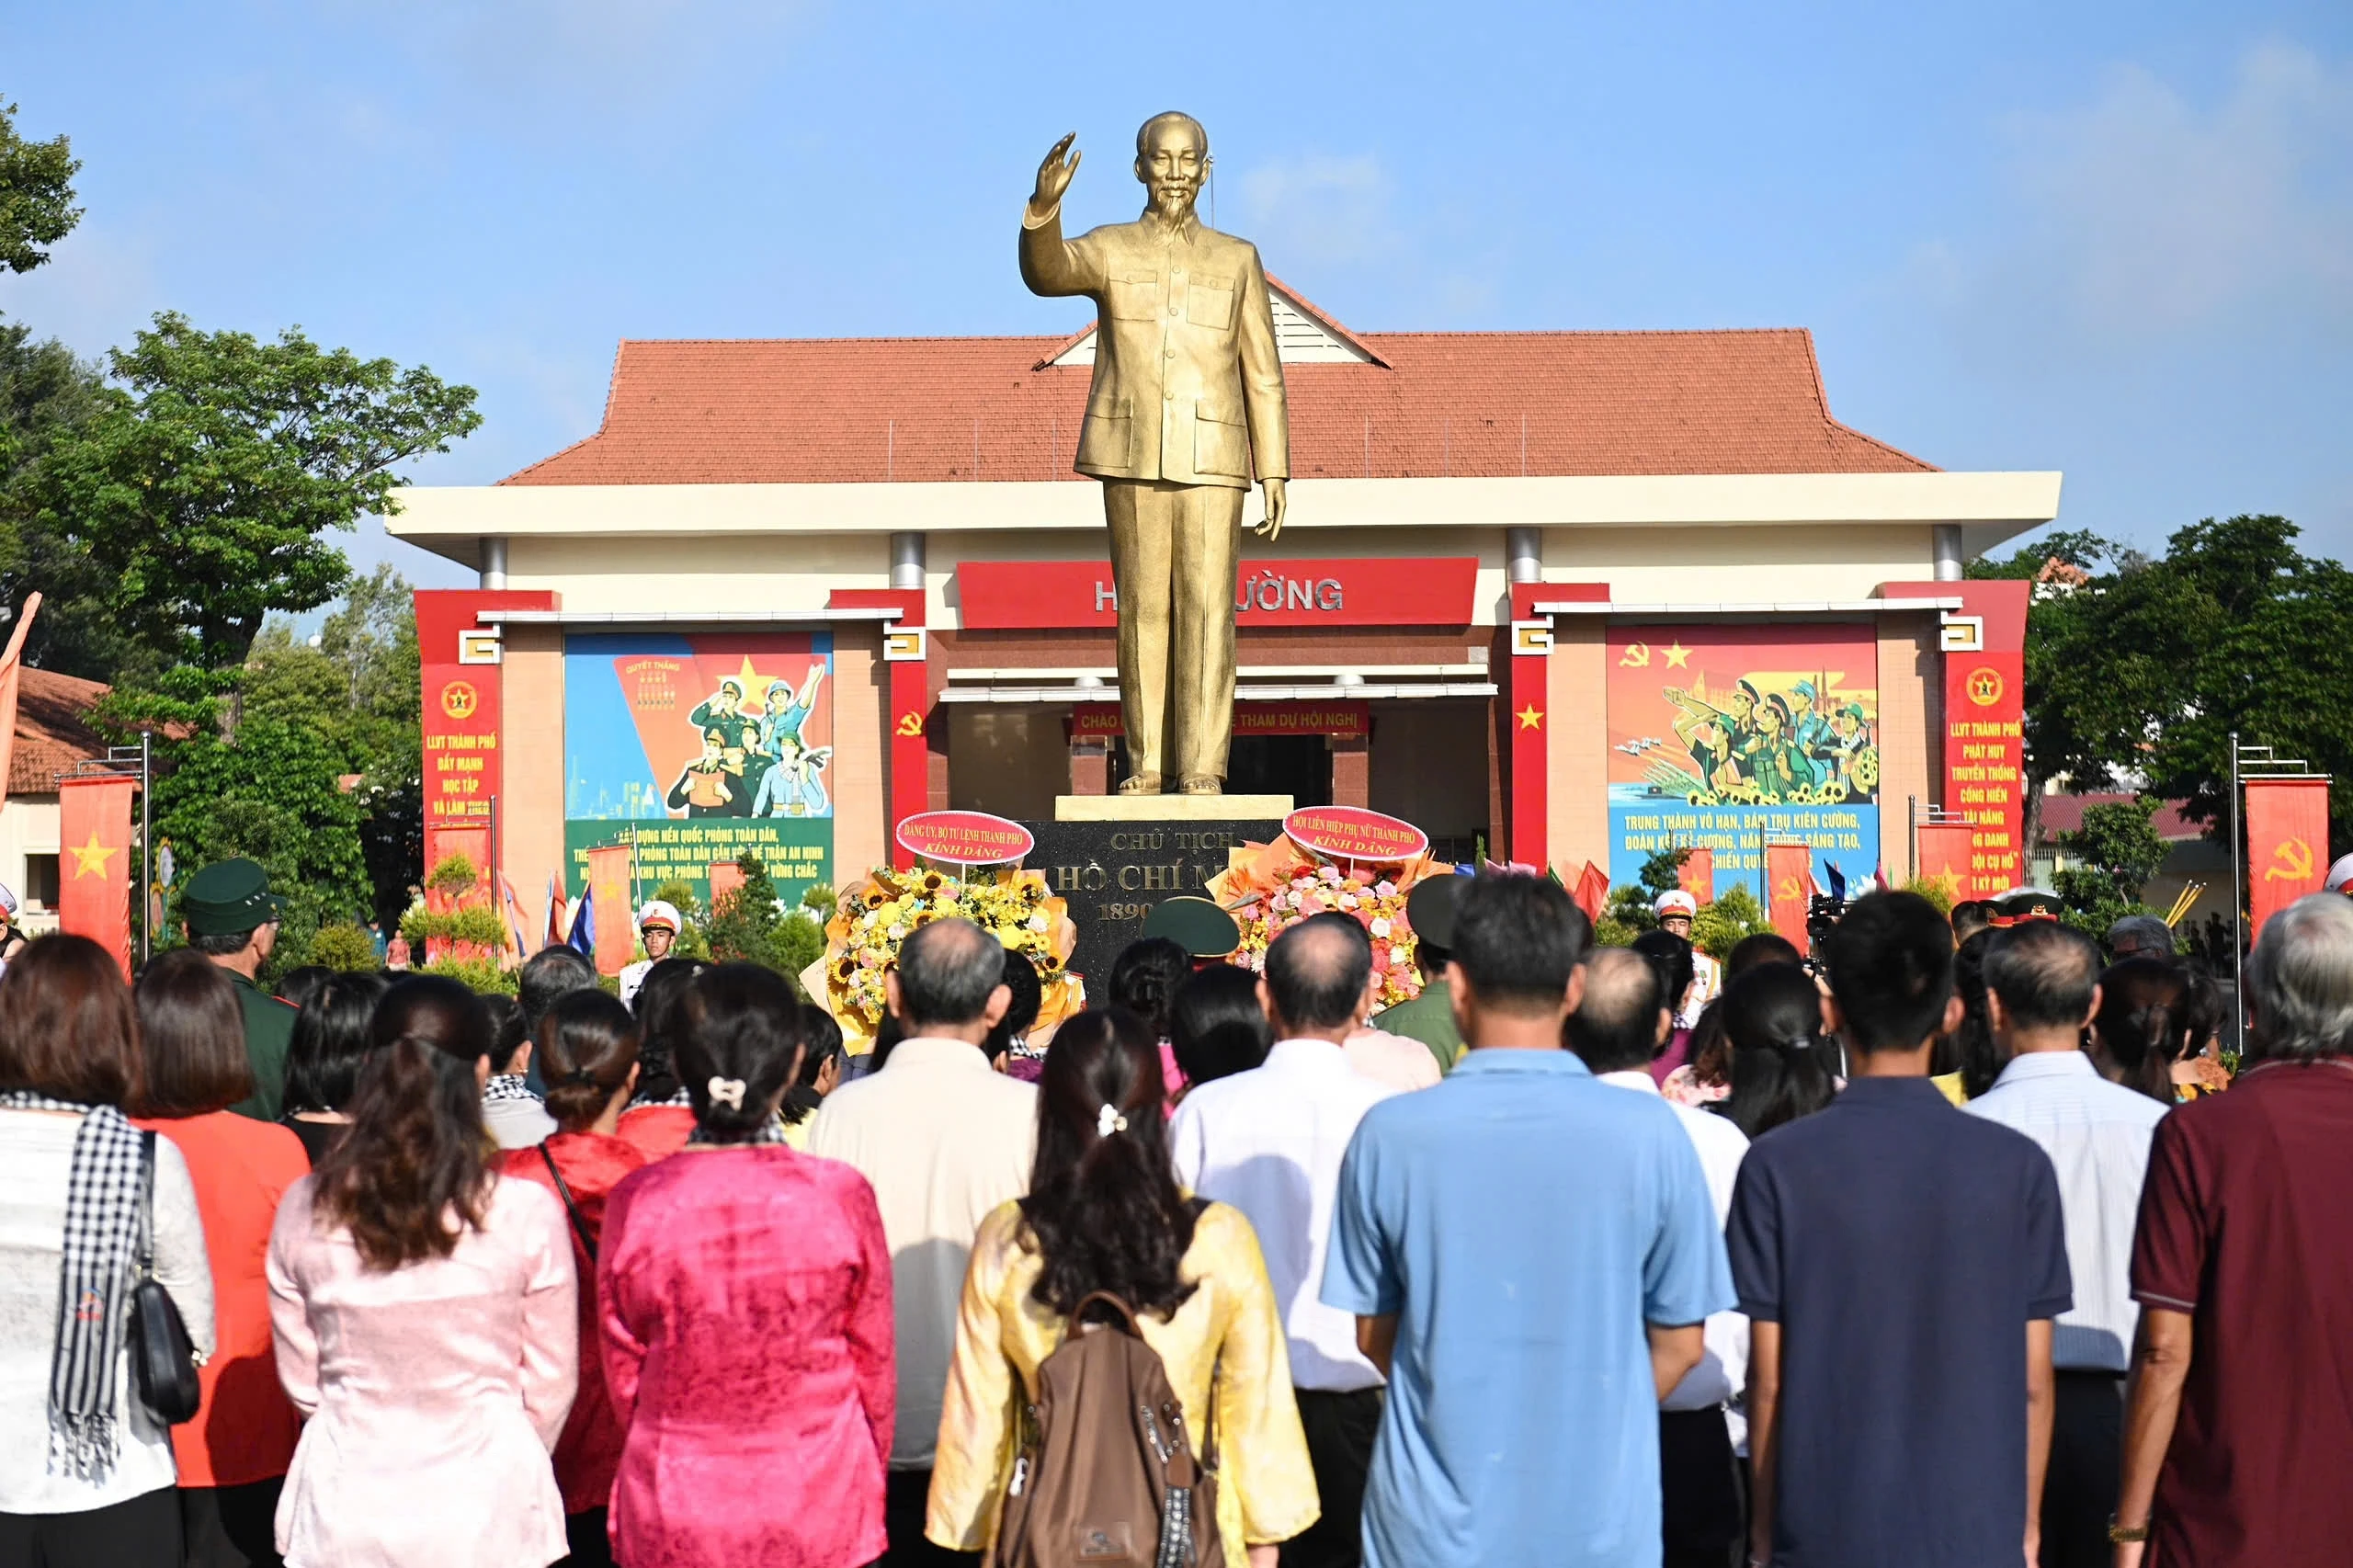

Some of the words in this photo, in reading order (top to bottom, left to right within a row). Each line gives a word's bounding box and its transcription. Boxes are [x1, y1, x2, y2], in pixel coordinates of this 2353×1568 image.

[1235, 570, 1343, 611] ƯỜNG
[1081, 712, 1118, 729] CHÀO
[1241, 713, 1276, 727] THAM
[1279, 712, 1298, 729] DỰ
[1301, 710, 1323, 729] HỘI
[1326, 712, 1358, 729] NGHỊ
[1950, 722, 1971, 737] LLVT
[1972, 720, 2001, 737] THÀNH
[2003, 718, 2021, 737] PHỐ
[426, 735, 445, 749] LLVT
[448, 732, 476, 750] THÀNH
[478, 731, 497, 750] PHỐ
[1962, 742, 1986, 760] PHÁT
[1987, 744, 2006, 759] HUY
[437, 752, 455, 771] ĐẨY
[457, 756, 483, 774] MẠNH
[1987, 762, 2017, 781] THỐNG
[442, 778, 460, 795] HỌC
[462, 776, 480, 796] TẬP
[1961, 784, 1984, 803] CỐNG
[1987, 785, 2007, 803] HIẾN
[433, 798, 446, 815] VÀ
[447, 798, 466, 815] LÀM
[468, 801, 490, 815] THEO
[1963, 808, 1978, 824] TÀI
[1979, 807, 2006, 825] NĂNG
[1293, 814, 1307, 830] HỘI
[1308, 814, 1325, 831] LIÊN
[1326, 819, 1344, 835] HIỆP
[1345, 824, 1358, 838] PHỤ
[1360, 823, 1373, 837] NỮ
[1372, 824, 1398, 842] THÀNH
[1625, 815, 1660, 830] TRUNG
[1662, 812, 1697, 829] THÀNH
[1699, 812, 1713, 829] VÔ
[1716, 813, 1741, 832] HẠN,
[1744, 812, 1767, 829] BÁM
[1770, 813, 1790, 829] TRỤ
[1793, 810, 1818, 828] KIÊN
[1821, 810, 1860, 829] CƯỜNG,
[636, 829, 660, 846] DỰNG
[681, 824, 703, 843] QUỐC
[704, 826, 733, 843] PHÒNG
[735, 825, 756, 843] TOÀN
[758, 825, 779, 843] DÂN,
[904, 821, 925, 837] ĐẢNG
[938, 827, 949, 841] BỘ
[949, 826, 960, 840] TƯ
[961, 828, 980, 843] LỆNH
[981, 826, 1006, 845] THÀNH
[1110, 827, 1164, 850] CHỦ
[1176, 832, 1235, 855] TỊCH
[1625, 833, 1654, 850] ĐOÀN
[1697, 834, 1736, 849] CƯƠNG,
[1805, 831, 1835, 849] SÁNG
[1837, 833, 1861, 851] TẠO,
[1985, 832, 2010, 847] DANH
[639, 845, 667, 862] PHÒNG
[669, 845, 691, 861] TOÀN
[693, 845, 711, 861] DÂN
[712, 843, 730, 860] GẮN
[765, 844, 787, 862] TRẬN
[788, 846, 801, 861] AN
[802, 846, 824, 861] NINH
[925, 841, 961, 855] KÍNH
[963, 845, 1004, 858] DÂNG
[1313, 835, 1350, 849] KÍNH
[1355, 841, 1398, 856] DÂNG
[639, 865, 655, 880] KHU
[656, 864, 673, 881] VỰC
[674, 862, 703, 880] PHÒNG
[770, 861, 793, 878] VỮNG
[794, 860, 818, 878] CHẮC
[1987, 854, 2000, 872] CỤ
[1054, 858, 1107, 892] HỒ
[1118, 858, 1184, 891] CHÍ
[1978, 874, 1991, 891] KỲ
[1992, 874, 2011, 891] MỚI
[1098, 903, 1154, 921] 1890
